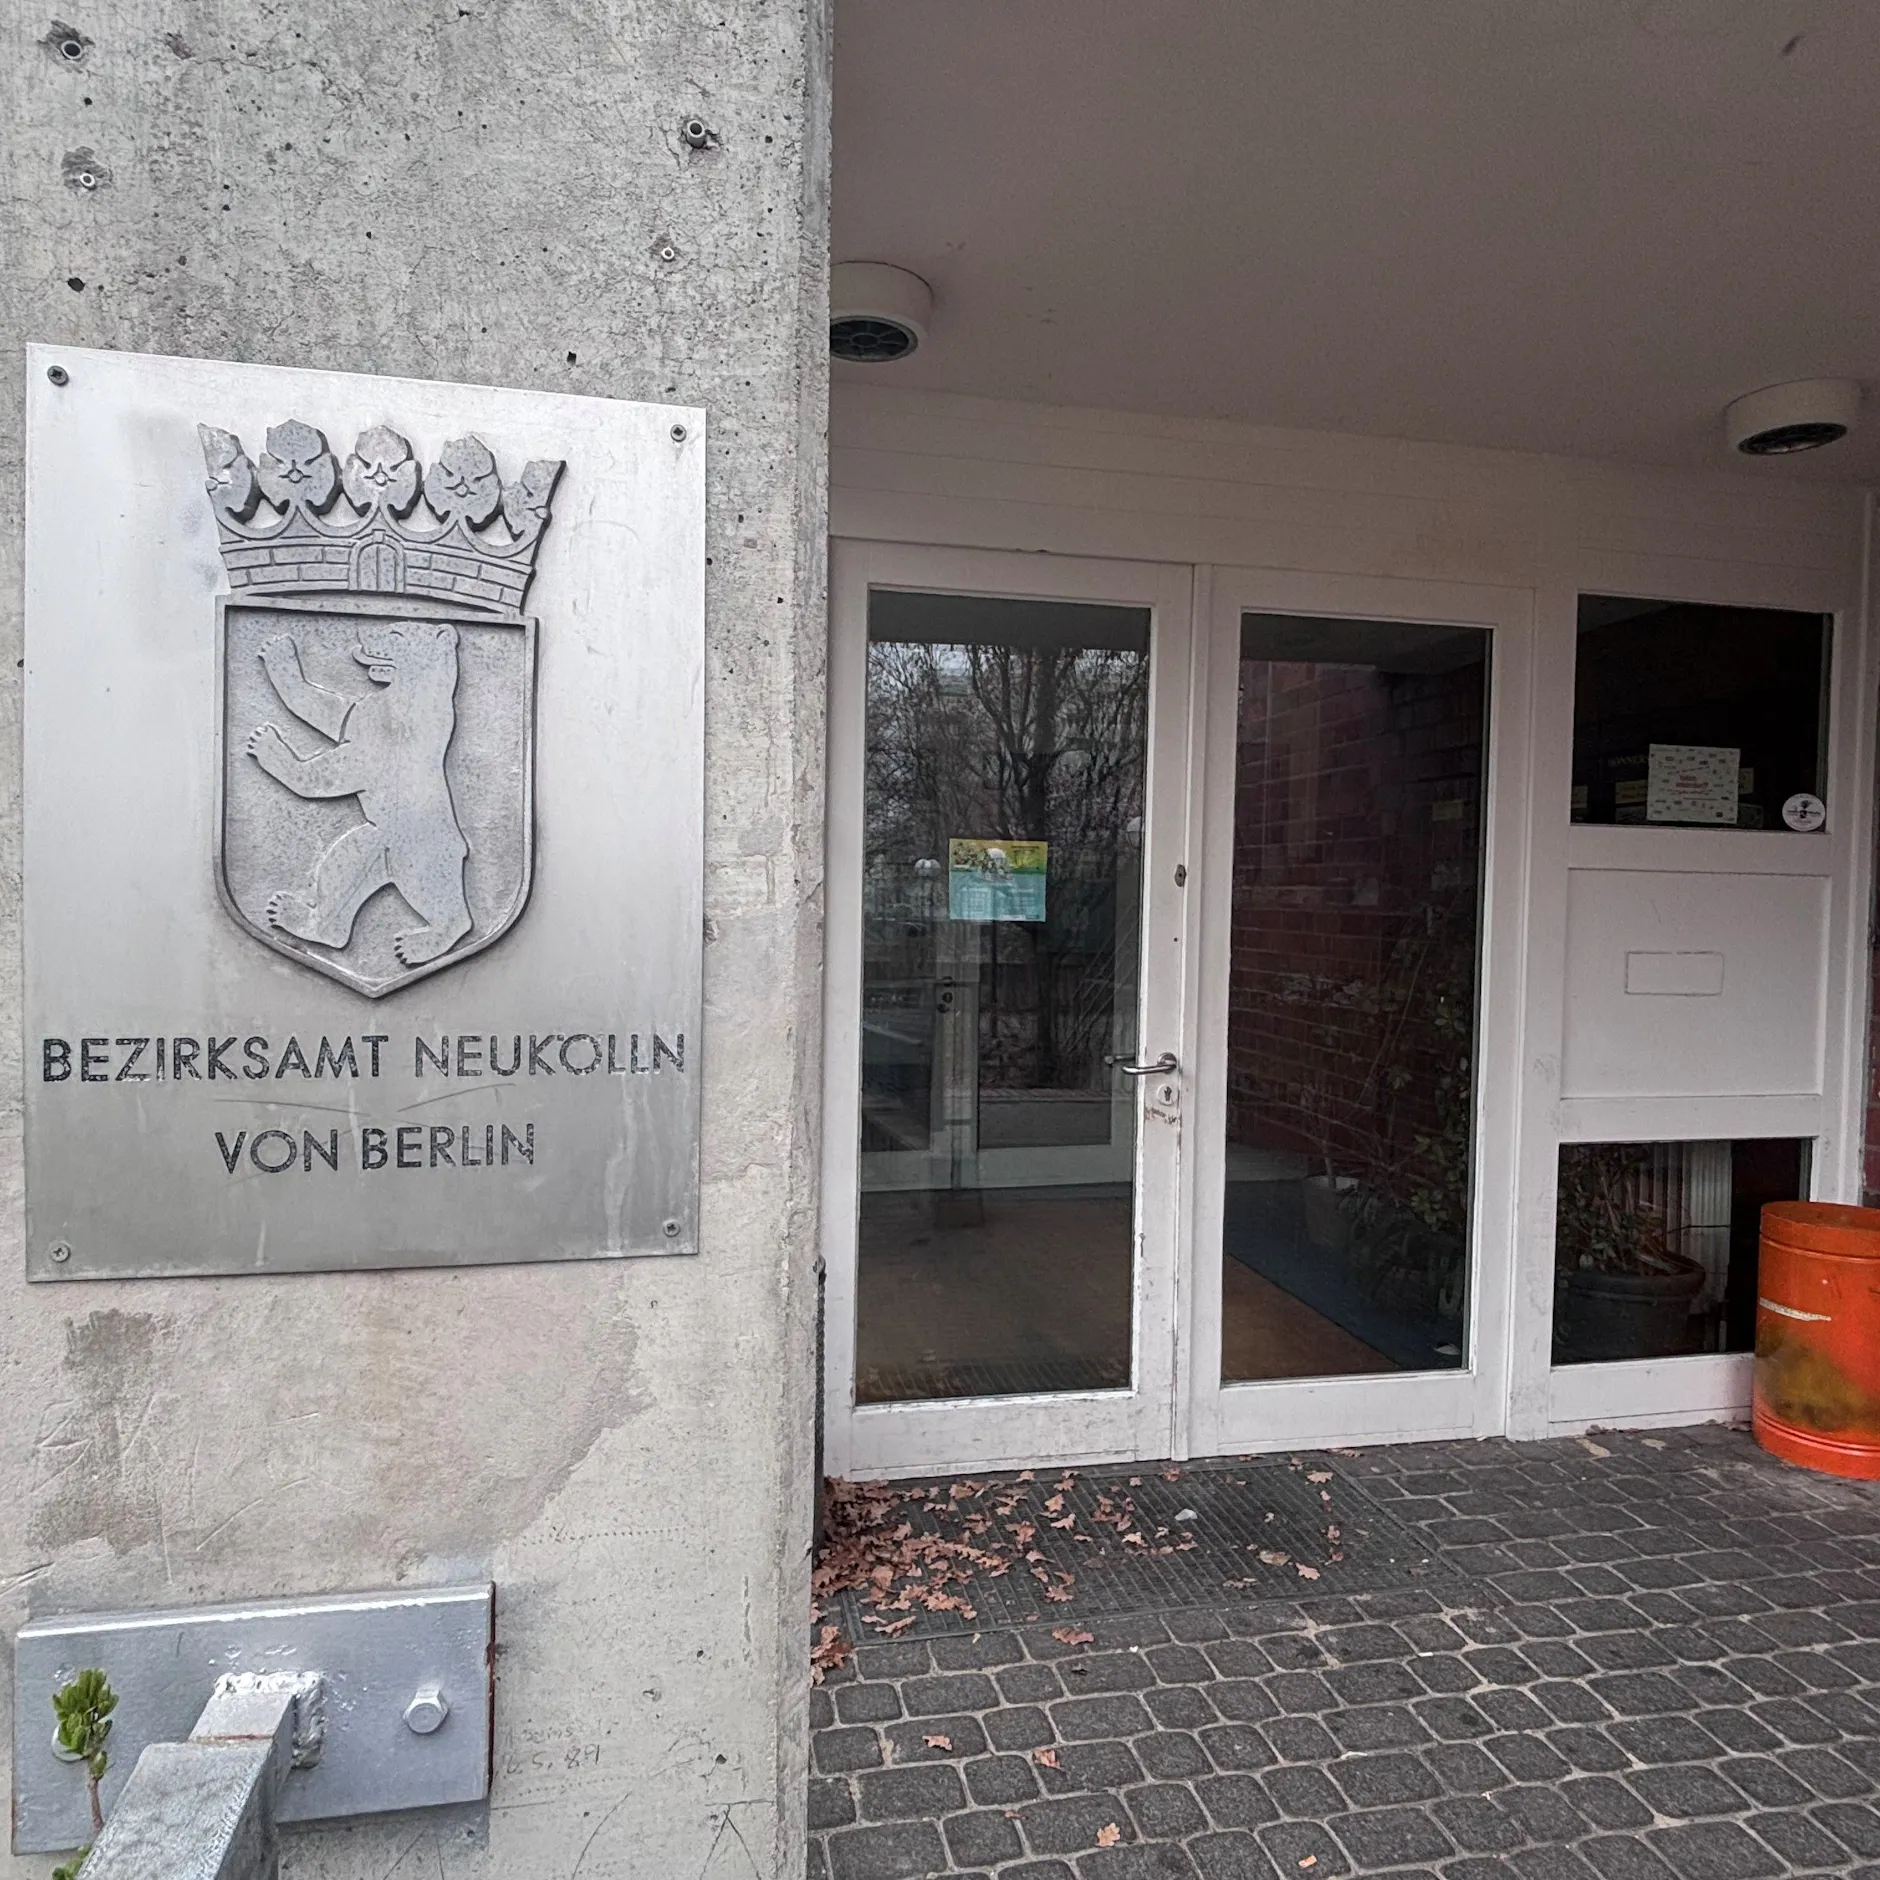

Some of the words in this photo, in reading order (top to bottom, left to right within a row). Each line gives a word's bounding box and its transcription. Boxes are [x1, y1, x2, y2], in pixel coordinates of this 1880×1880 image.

[42, 1035, 389, 1082] BEZIRKSAMT
[214, 1128, 338, 1174] VON
[361, 1123, 535, 1170] BERLIN
